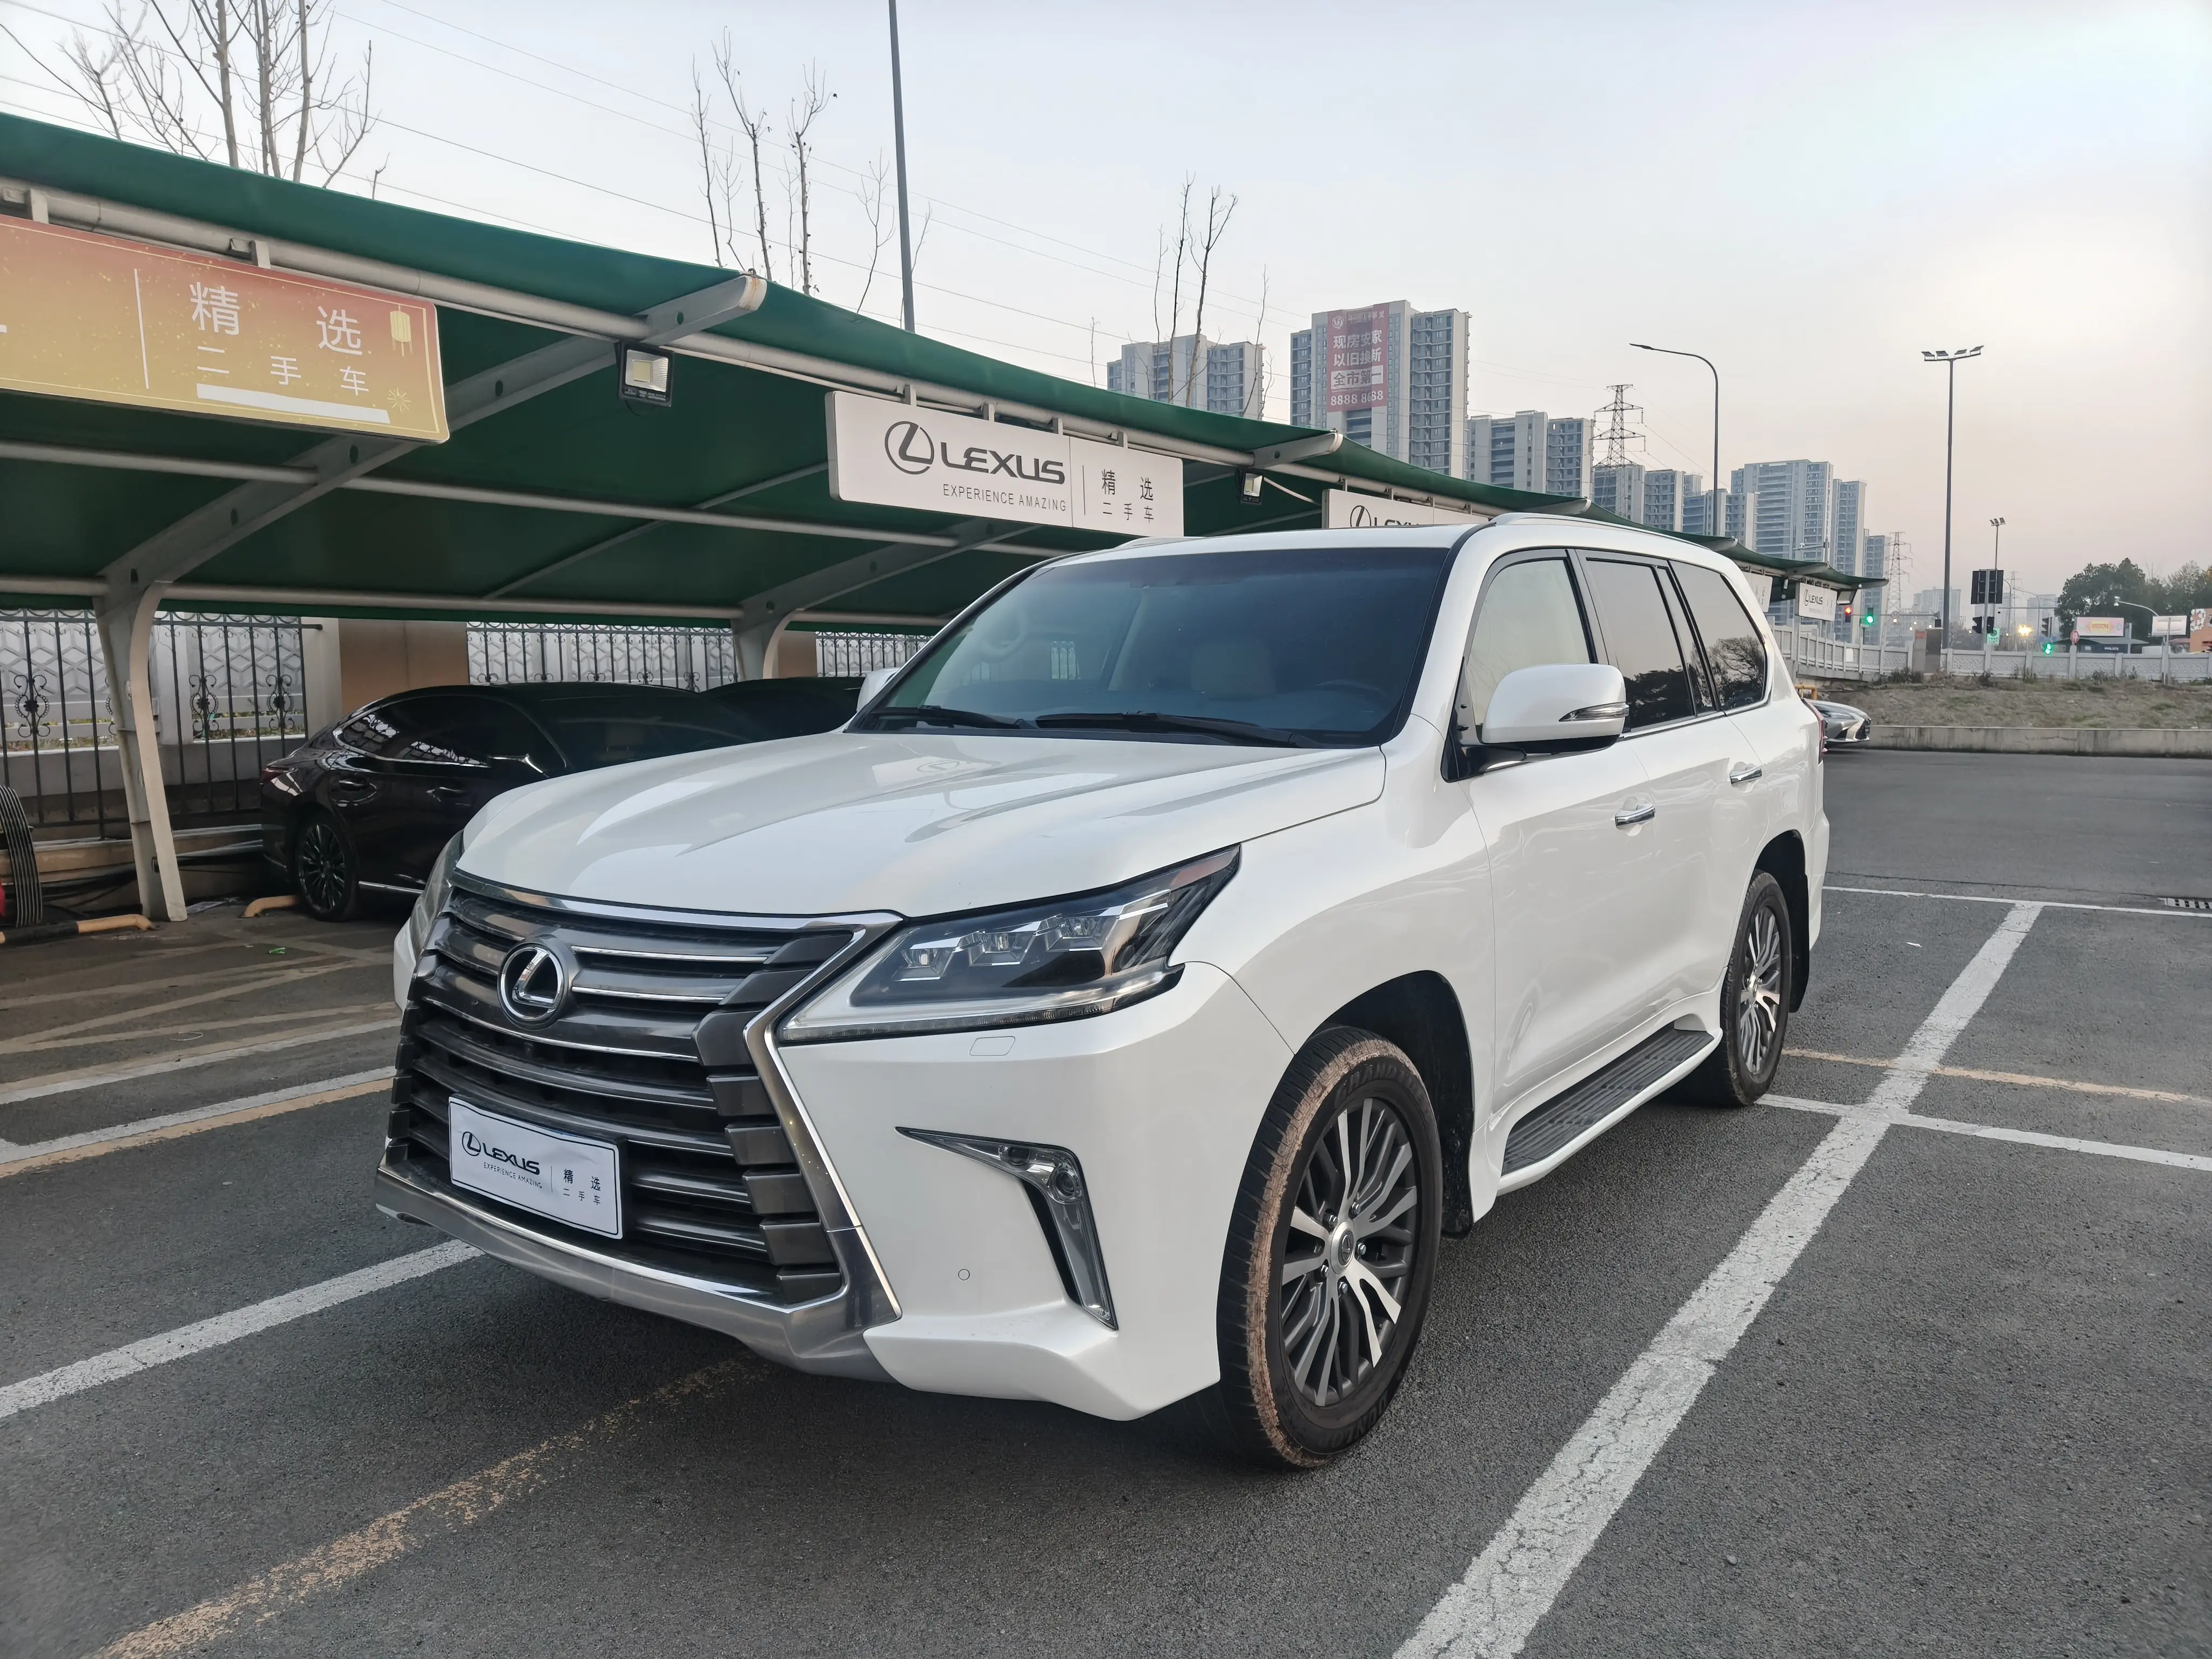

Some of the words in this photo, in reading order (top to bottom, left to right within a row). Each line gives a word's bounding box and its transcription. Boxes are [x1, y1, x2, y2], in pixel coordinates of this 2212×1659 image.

[190, 281, 363, 355] 精选
[1333, 329, 1382, 349] 现房安家
[1333, 347, 1381, 367] 以旧换新
[197, 346, 369, 396] 二手车
[1333, 369, 1381, 387] 全市第一
[1331, 394, 1358, 406] 8888
[941, 442, 1065, 484] LEXUS
[1102, 469, 1153, 501] 精选
[943, 484, 1014, 504] EXPERIENCE
[1019, 495, 1066, 511] AMAZING
[1103, 502, 1154, 523] 二手车
[1809, 595, 1823, 605] LEXUS
[482, 1142, 540, 1175] LEXUS
[484, 1162, 516, 1179] EXPERIENCE
[518, 1175, 542, 1189] AMAZING
[563, 1168, 601, 1191] 精选
[563, 1188, 601, 1205] 二手车
